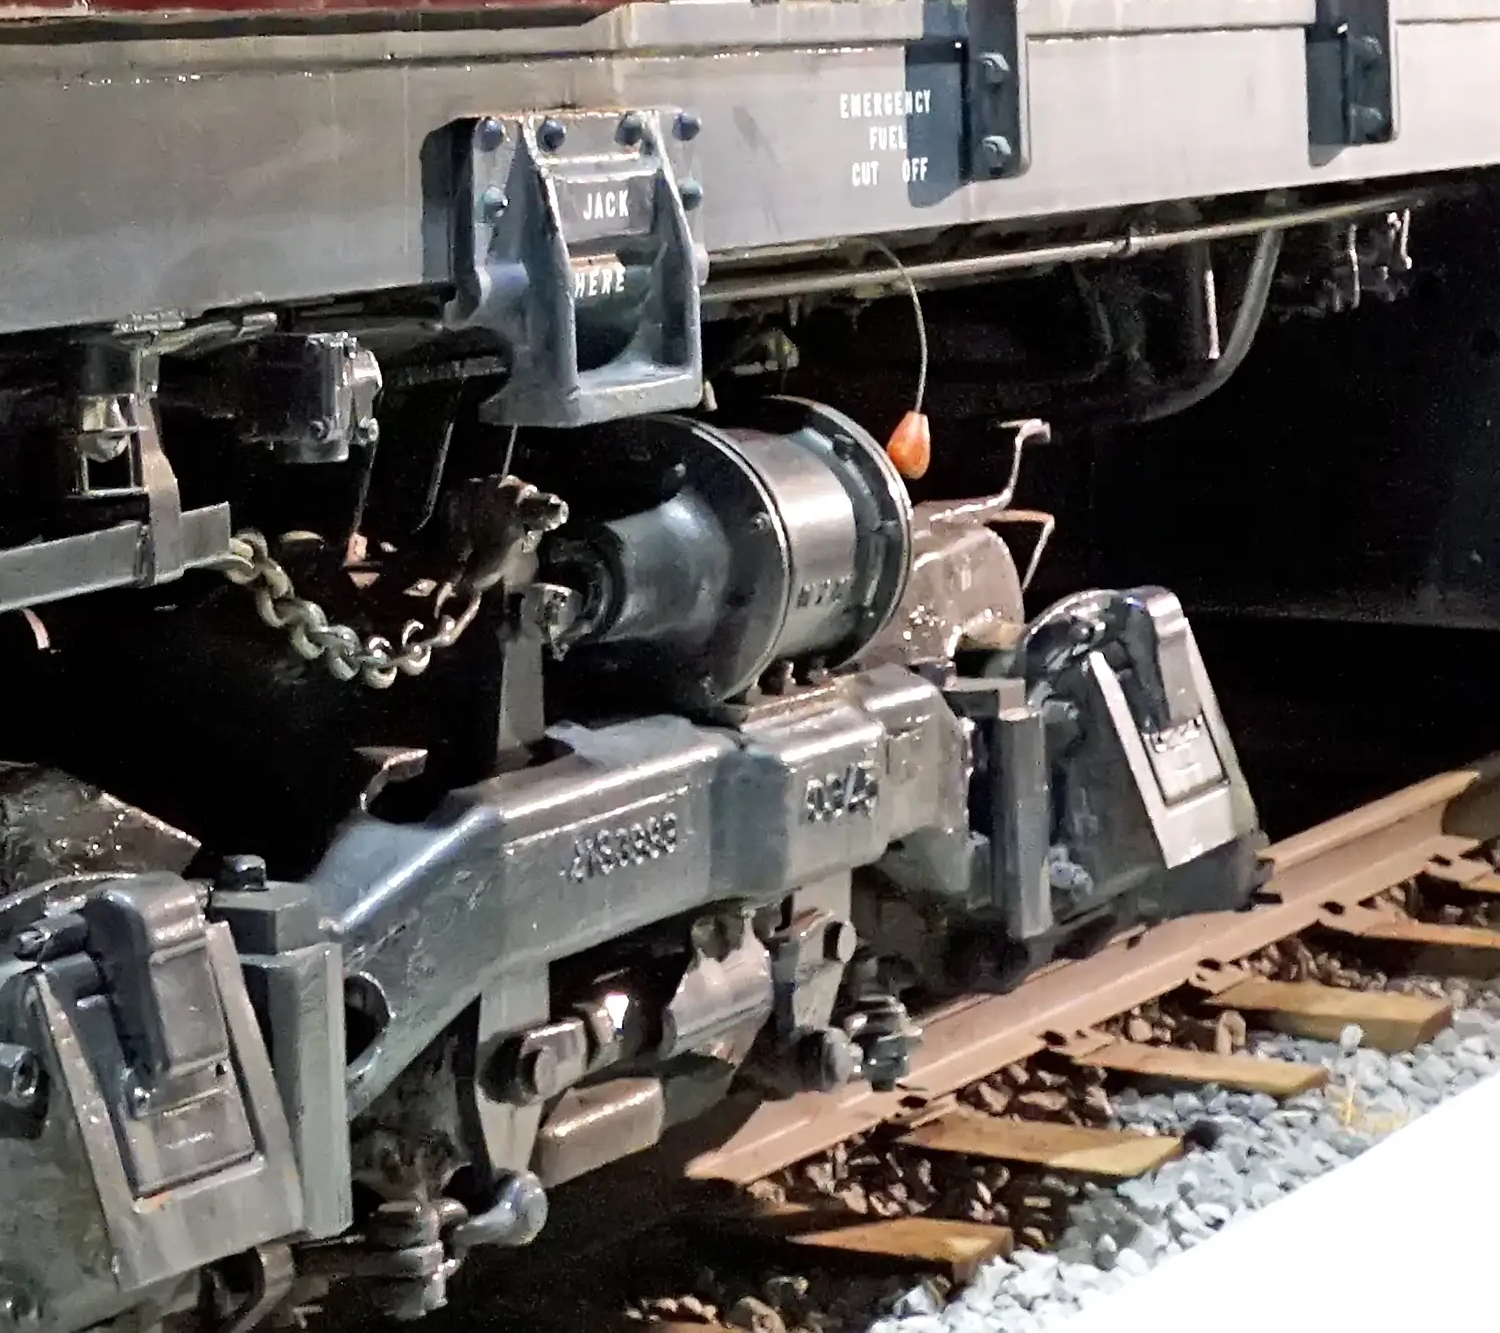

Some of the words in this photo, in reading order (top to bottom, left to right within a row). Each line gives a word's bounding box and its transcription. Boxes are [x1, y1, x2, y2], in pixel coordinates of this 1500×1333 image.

[840, 89, 931, 119] EMERGENCY
[869, 124, 908, 152] FUEL
[851, 160, 880, 187] CUT
[901, 156, 929, 184] OFF
[582, 189, 630, 220] JACK
[574, 264, 627, 299] HERE
